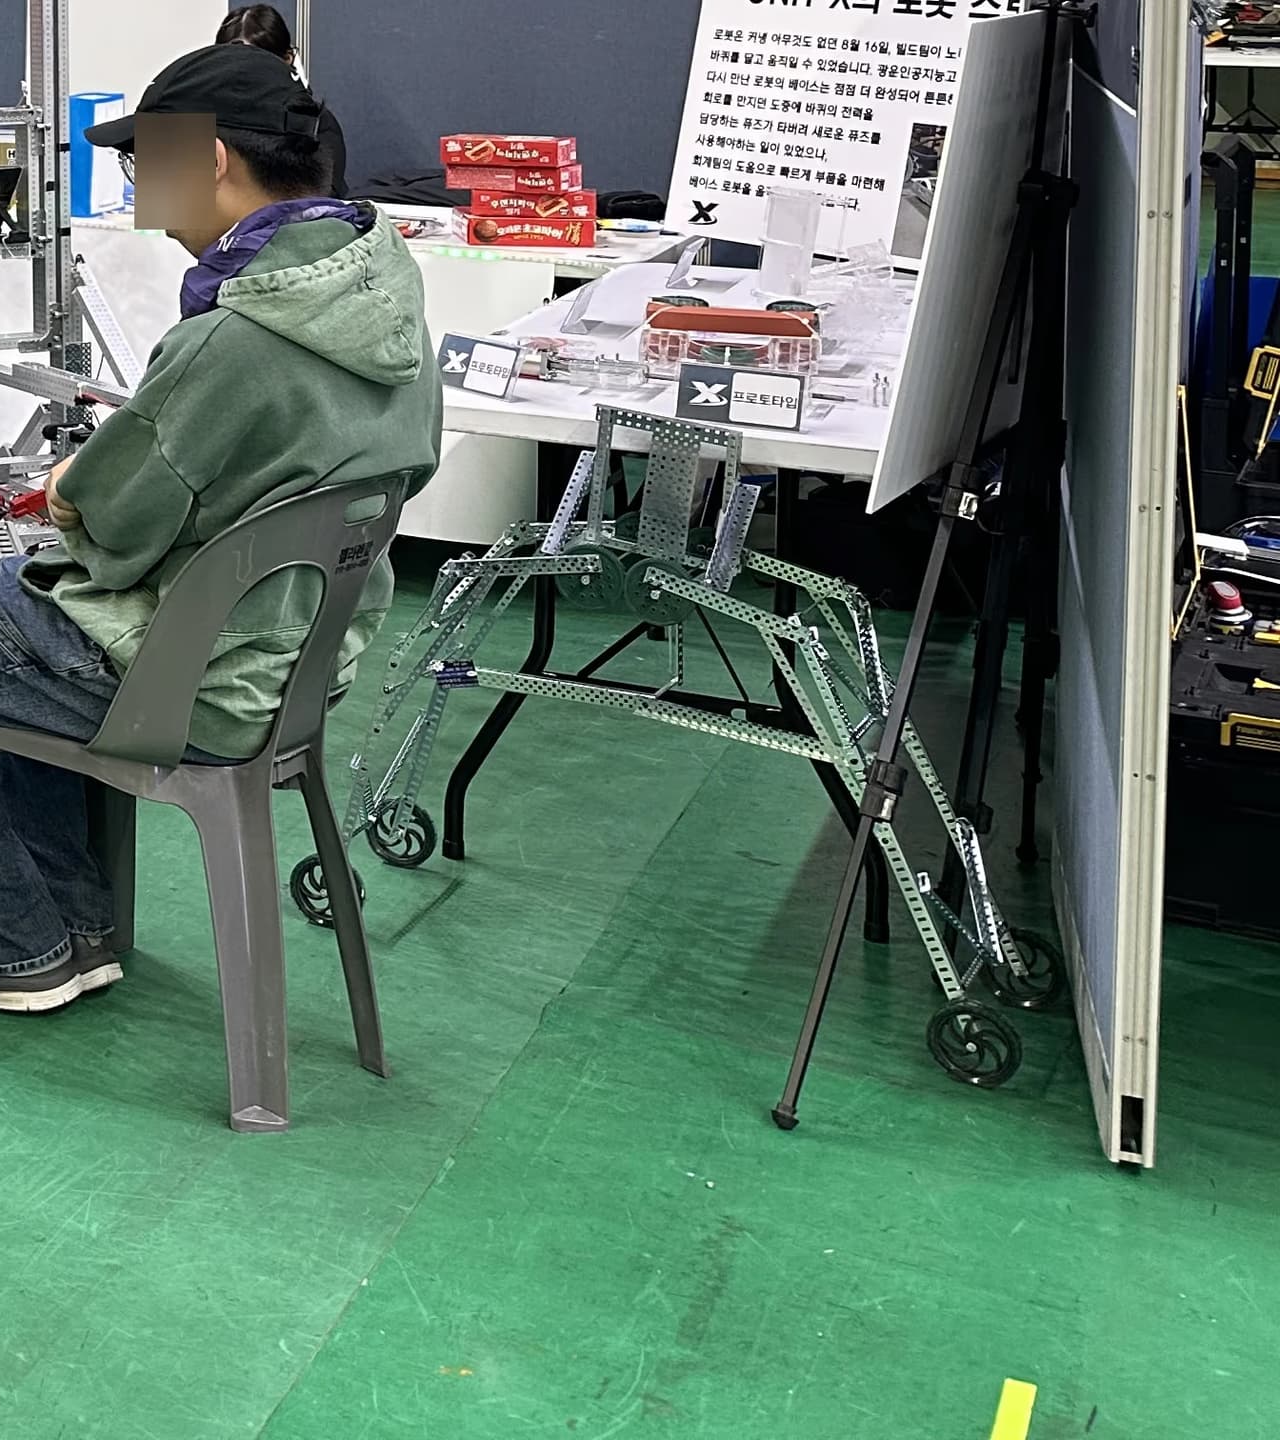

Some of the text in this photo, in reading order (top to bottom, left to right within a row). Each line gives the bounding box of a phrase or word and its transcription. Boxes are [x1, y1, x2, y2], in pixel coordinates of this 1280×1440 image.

[713, 29, 743, 43] 로봇은
[747, 31, 768, 45] 커녕
[771, 33, 813, 48] 아무것도
[817, 36, 838, 51] 없던
[841, 39, 860, 52] 8월
[865, 40, 891, 56] 16일,
[896, 43, 942, 59] 빌드팀이
[710, 50, 739, 64] 바퀴를
[744, 52, 763, 65] 달고
[768, 53, 798, 69] 움직일
[802, 57, 813, 70] 수
[817, 59, 873, 76] 있었습니다.
[706, 70, 727, 84] 다시
[730, 72, 751, 86] 만난
[753, 74, 784, 89] 로봇의
[788, 78, 830, 94] 베이스는
[834, 82, 856, 97] 점점
[860, 85, 871, 98] 더
[874, 86, 920, 104] 완성되어
[703, 91, 873, 121] 회로를 만지던 도중에 바퀴의 전력을
[699, 113, 881, 145] 담당하는 퓨즈가 타버려 새로운 퓨즈를
[695, 134, 828, 162] 사용해야하는 일이 있었으나,
[689, 176, 719, 191] 베이스
[721, 180, 751, 195] 로봇을
[691, 154, 885, 191] 회계팀의 도움으로 빠르게 부품을 마련해
[470, 362, 510, 379] 프로토타입
[733, 390, 798, 410] 프로토타입
